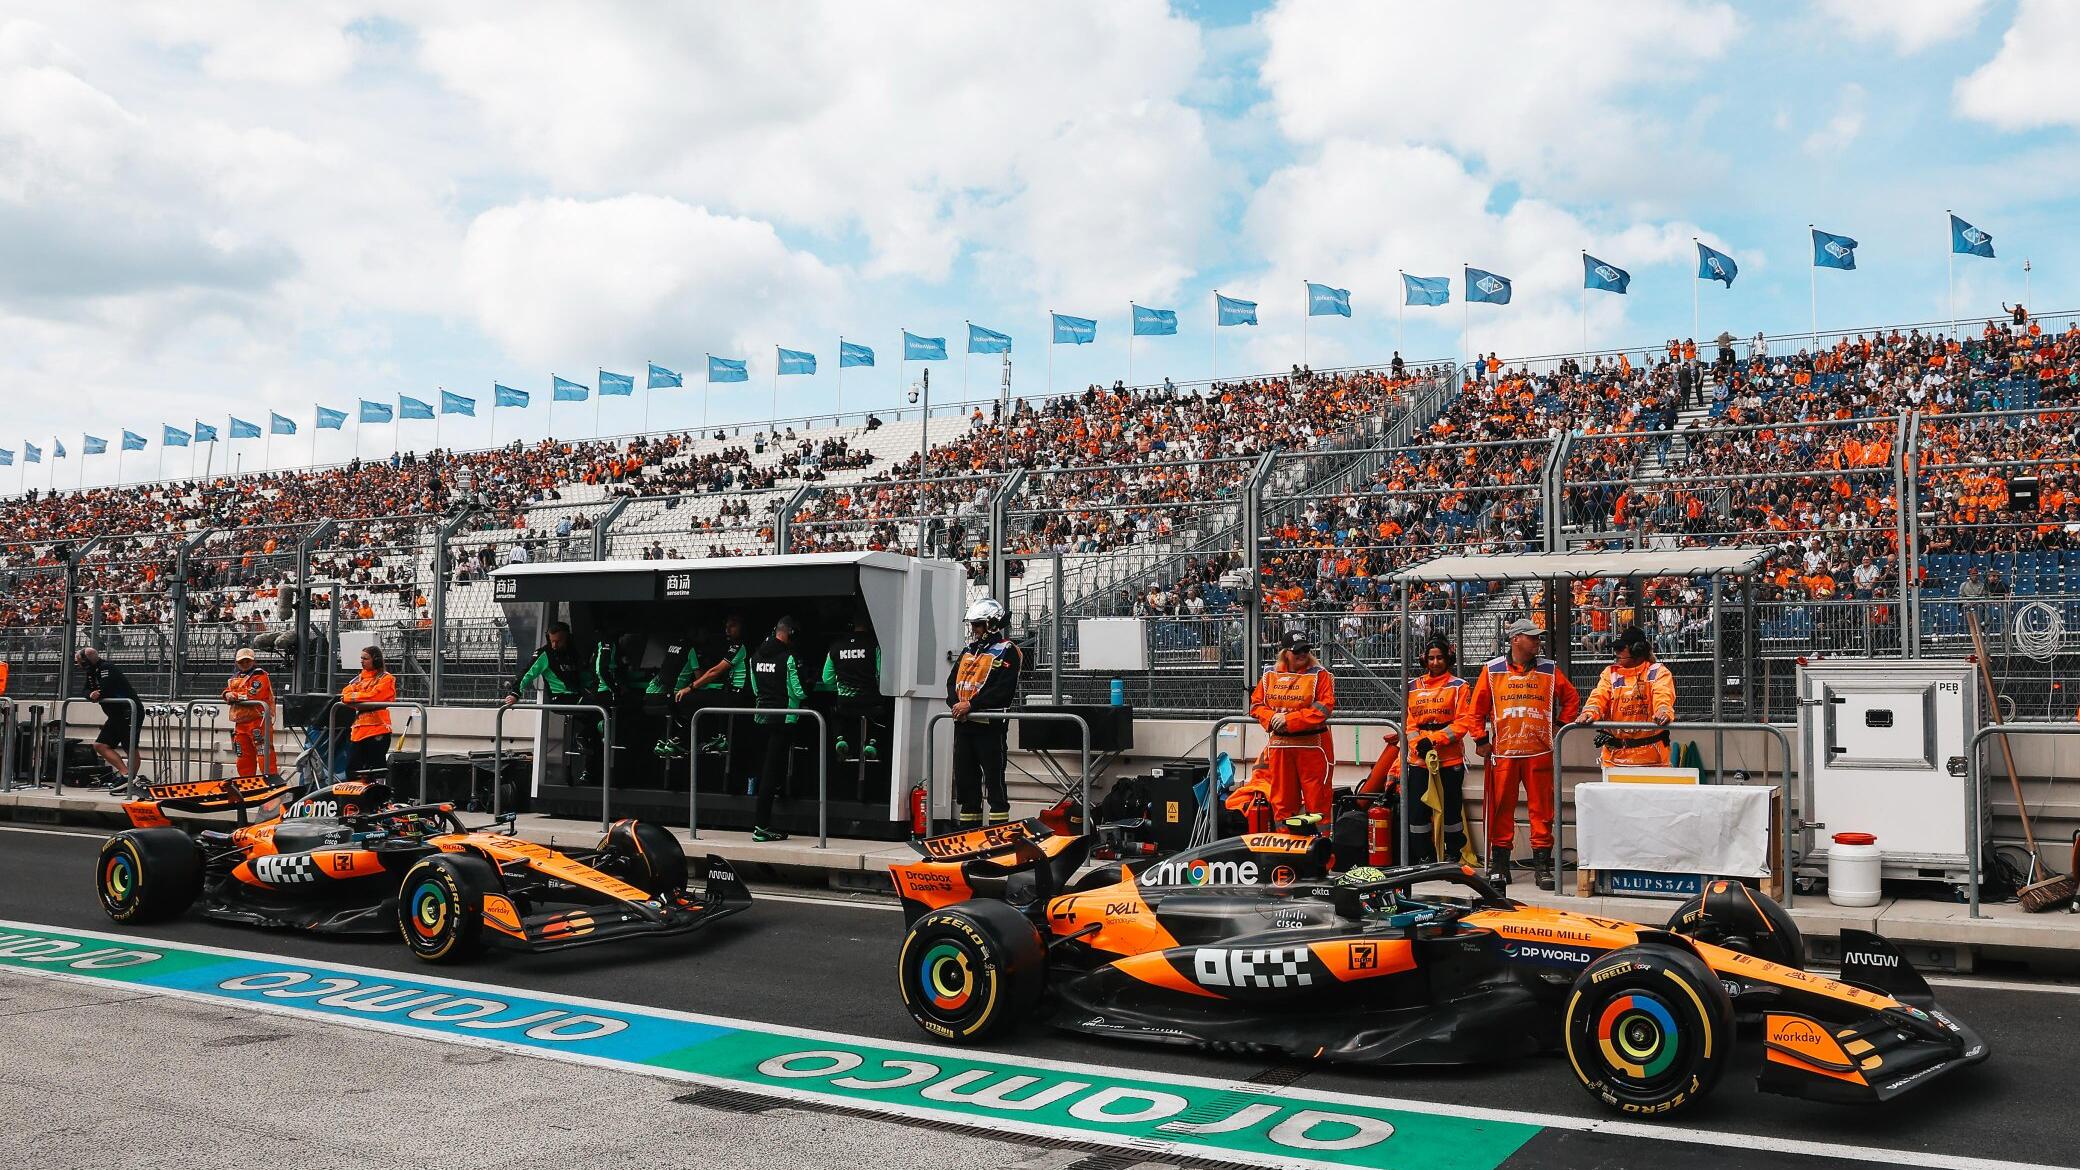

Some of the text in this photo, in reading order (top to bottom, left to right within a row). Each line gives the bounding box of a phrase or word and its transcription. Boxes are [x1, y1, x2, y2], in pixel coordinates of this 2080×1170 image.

[667, 575, 690, 590] 商汤
[839, 649, 866, 660] KICK
[756, 663, 776, 673] KICK
[1939, 683, 1959, 692] PEB
[1249, 836, 1307, 852] allwyn
[708, 870, 735, 881] ARROW
[905, 871, 951, 883] Dropbox
[1141, 859, 1259, 887] chrome
[910, 883, 938, 892] Dash
[1311, 887, 1330, 896] okta
[487, 907, 510, 916] workday
[1105, 902, 1140, 916] DELL
[940, 916, 984, 945] ZERO
[1276, 919, 1303, 930] cisco
[1502, 925, 1592, 942] RICHARD MILLE
[1521, 947, 1591, 963] DP WORLD
[1845, 951, 1899, 968] ARROW
[1194, 948, 1313, 988] OKX
[1591, 961, 1632, 984] PIRELLI
[218, 971, 630, 1041] aramco
[1773, 1031, 1821, 1044] workday
[756, 1050, 1396, 1150] aramco
[1622, 1092, 1686, 1114] ZERO
